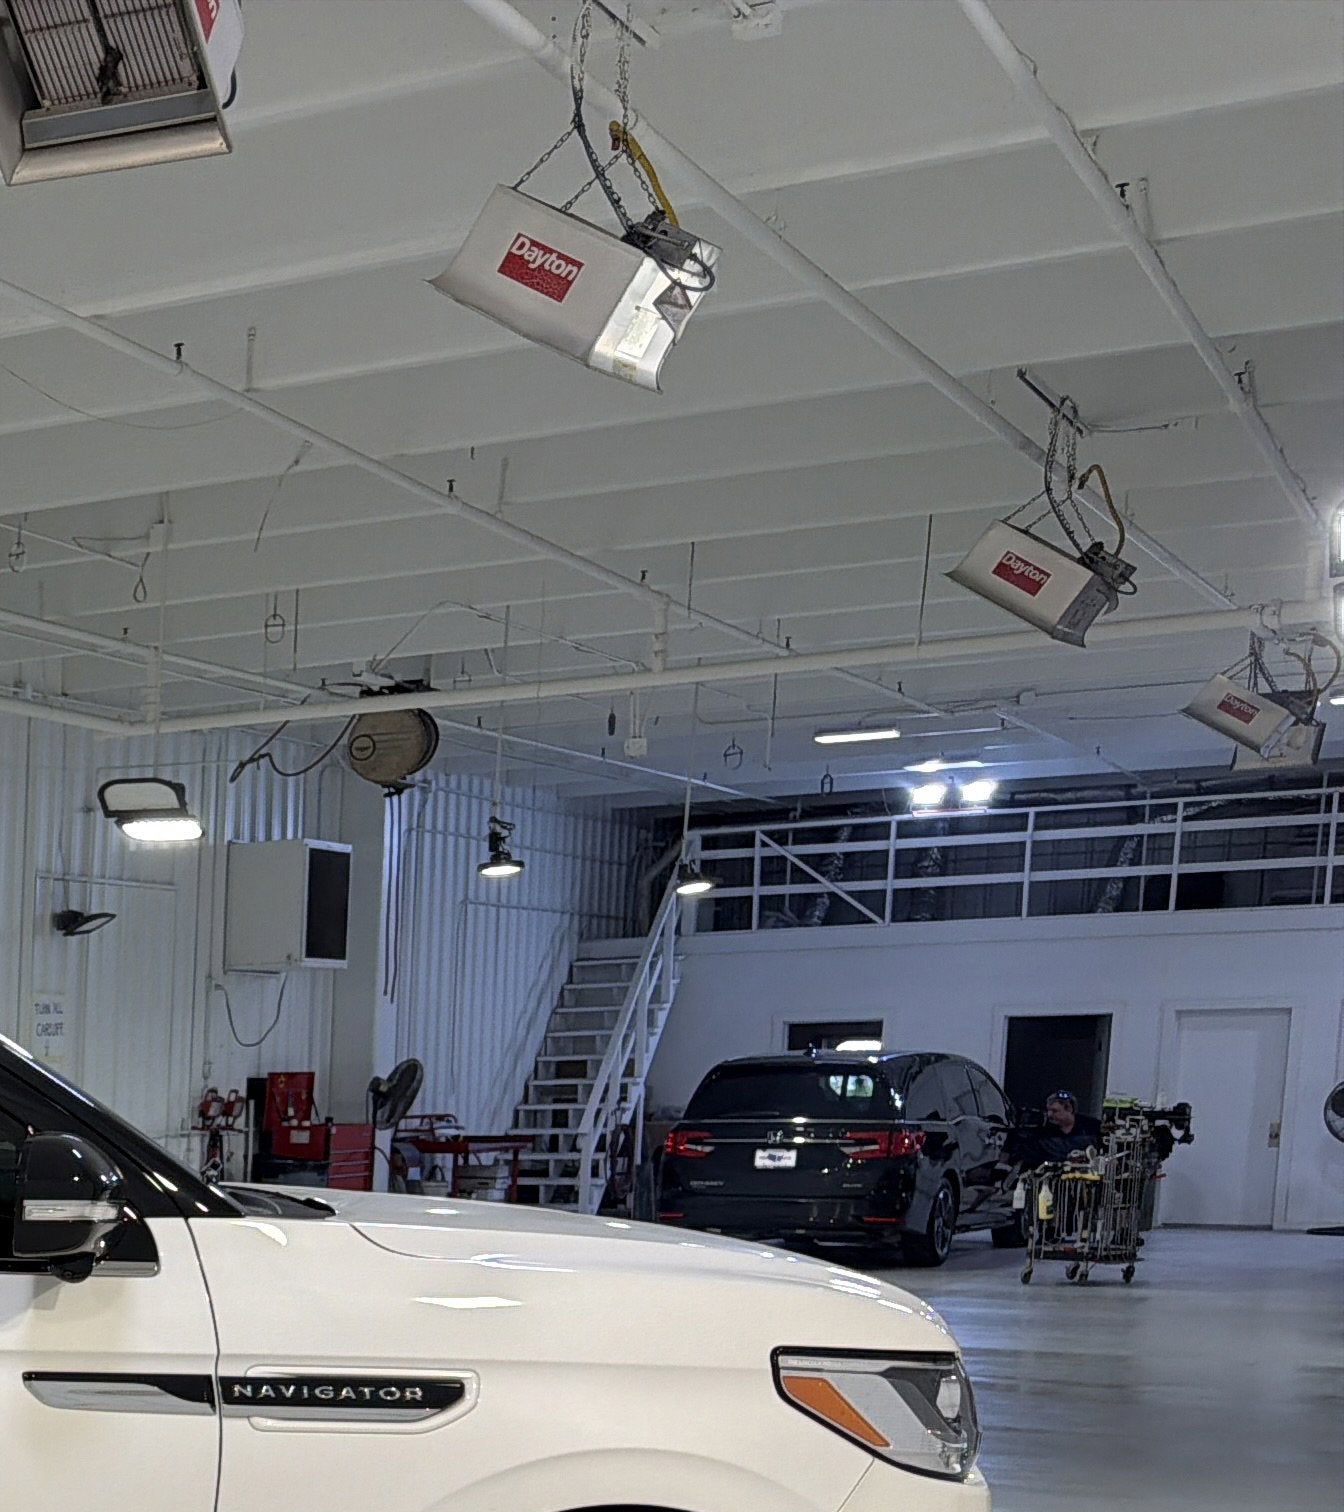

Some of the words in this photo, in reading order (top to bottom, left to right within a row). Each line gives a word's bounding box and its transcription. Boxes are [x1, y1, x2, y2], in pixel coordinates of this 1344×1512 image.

[511, 236, 580, 281] Dayton
[1001, 553, 1049, 584] Dayton
[233, 1384, 424, 1401] NAVIGATOR
